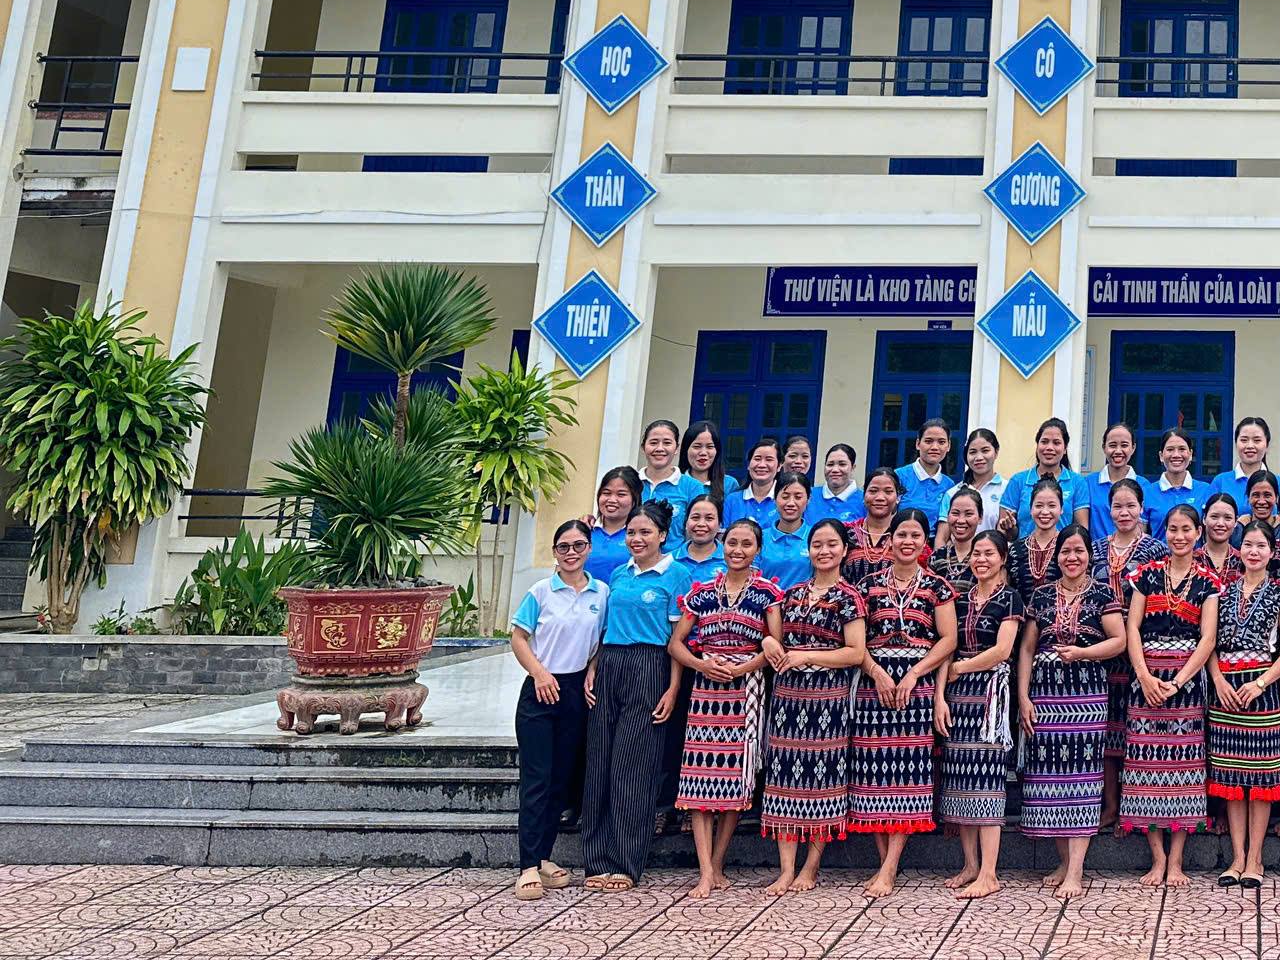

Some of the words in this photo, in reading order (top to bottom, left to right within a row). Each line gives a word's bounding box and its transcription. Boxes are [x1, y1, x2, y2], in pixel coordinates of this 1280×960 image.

[600, 46, 632, 83] HỌC
[1035, 42, 1055, 78] CÔ
[585, 169, 625, 207] THÂN
[1010, 172, 1060, 206] GƯƠNG
[784, 277, 815, 302] THƯ
[817, 274, 853, 307] VIỆN
[856, 274, 875, 302] LÀ
[879, 279, 910, 302] KHO
[914, 274, 955, 302] TÀNG
[1093, 272, 1118, 303] CẢI
[1122, 280, 1157, 303] TINH
[1160, 272, 1200, 303] THẦN
[1204, 273, 1235, 304] CỦA
[1238, 276, 1272, 304] LOÀI
[565, 298, 611, 344] THIỆN
[1012, 292, 1047, 337] MẪU
